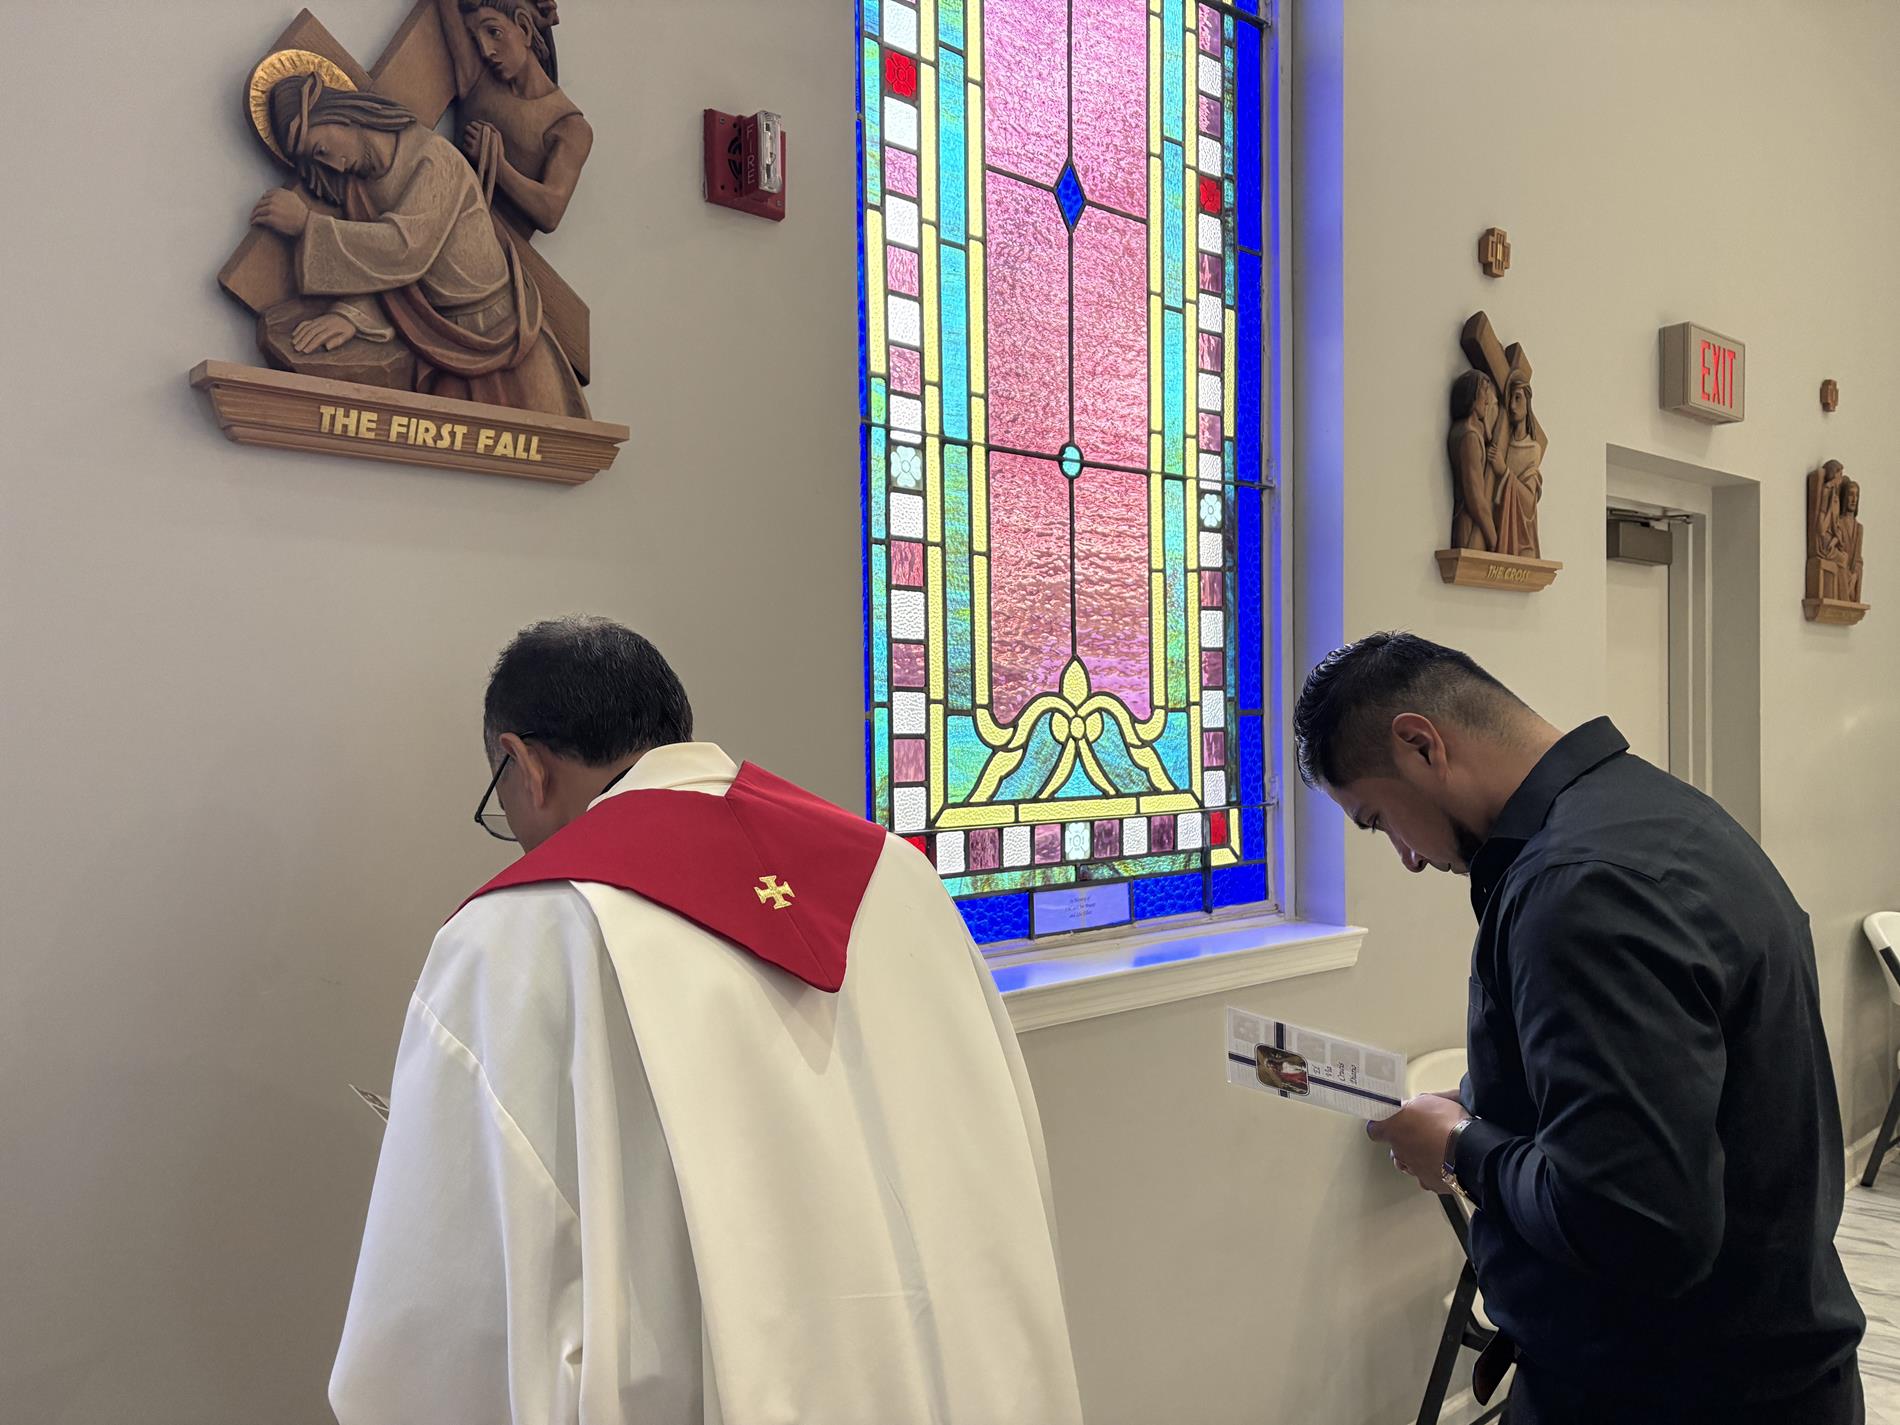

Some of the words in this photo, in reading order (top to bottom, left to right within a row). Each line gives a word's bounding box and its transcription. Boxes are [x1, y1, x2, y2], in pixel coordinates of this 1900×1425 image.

[746, 123, 756, 185] FIRE
[1701, 339, 1736, 409] EXIT
[319, 405, 378, 440] THE
[388, 416, 468, 451] FIRST
[476, 429, 542, 462] FALL
